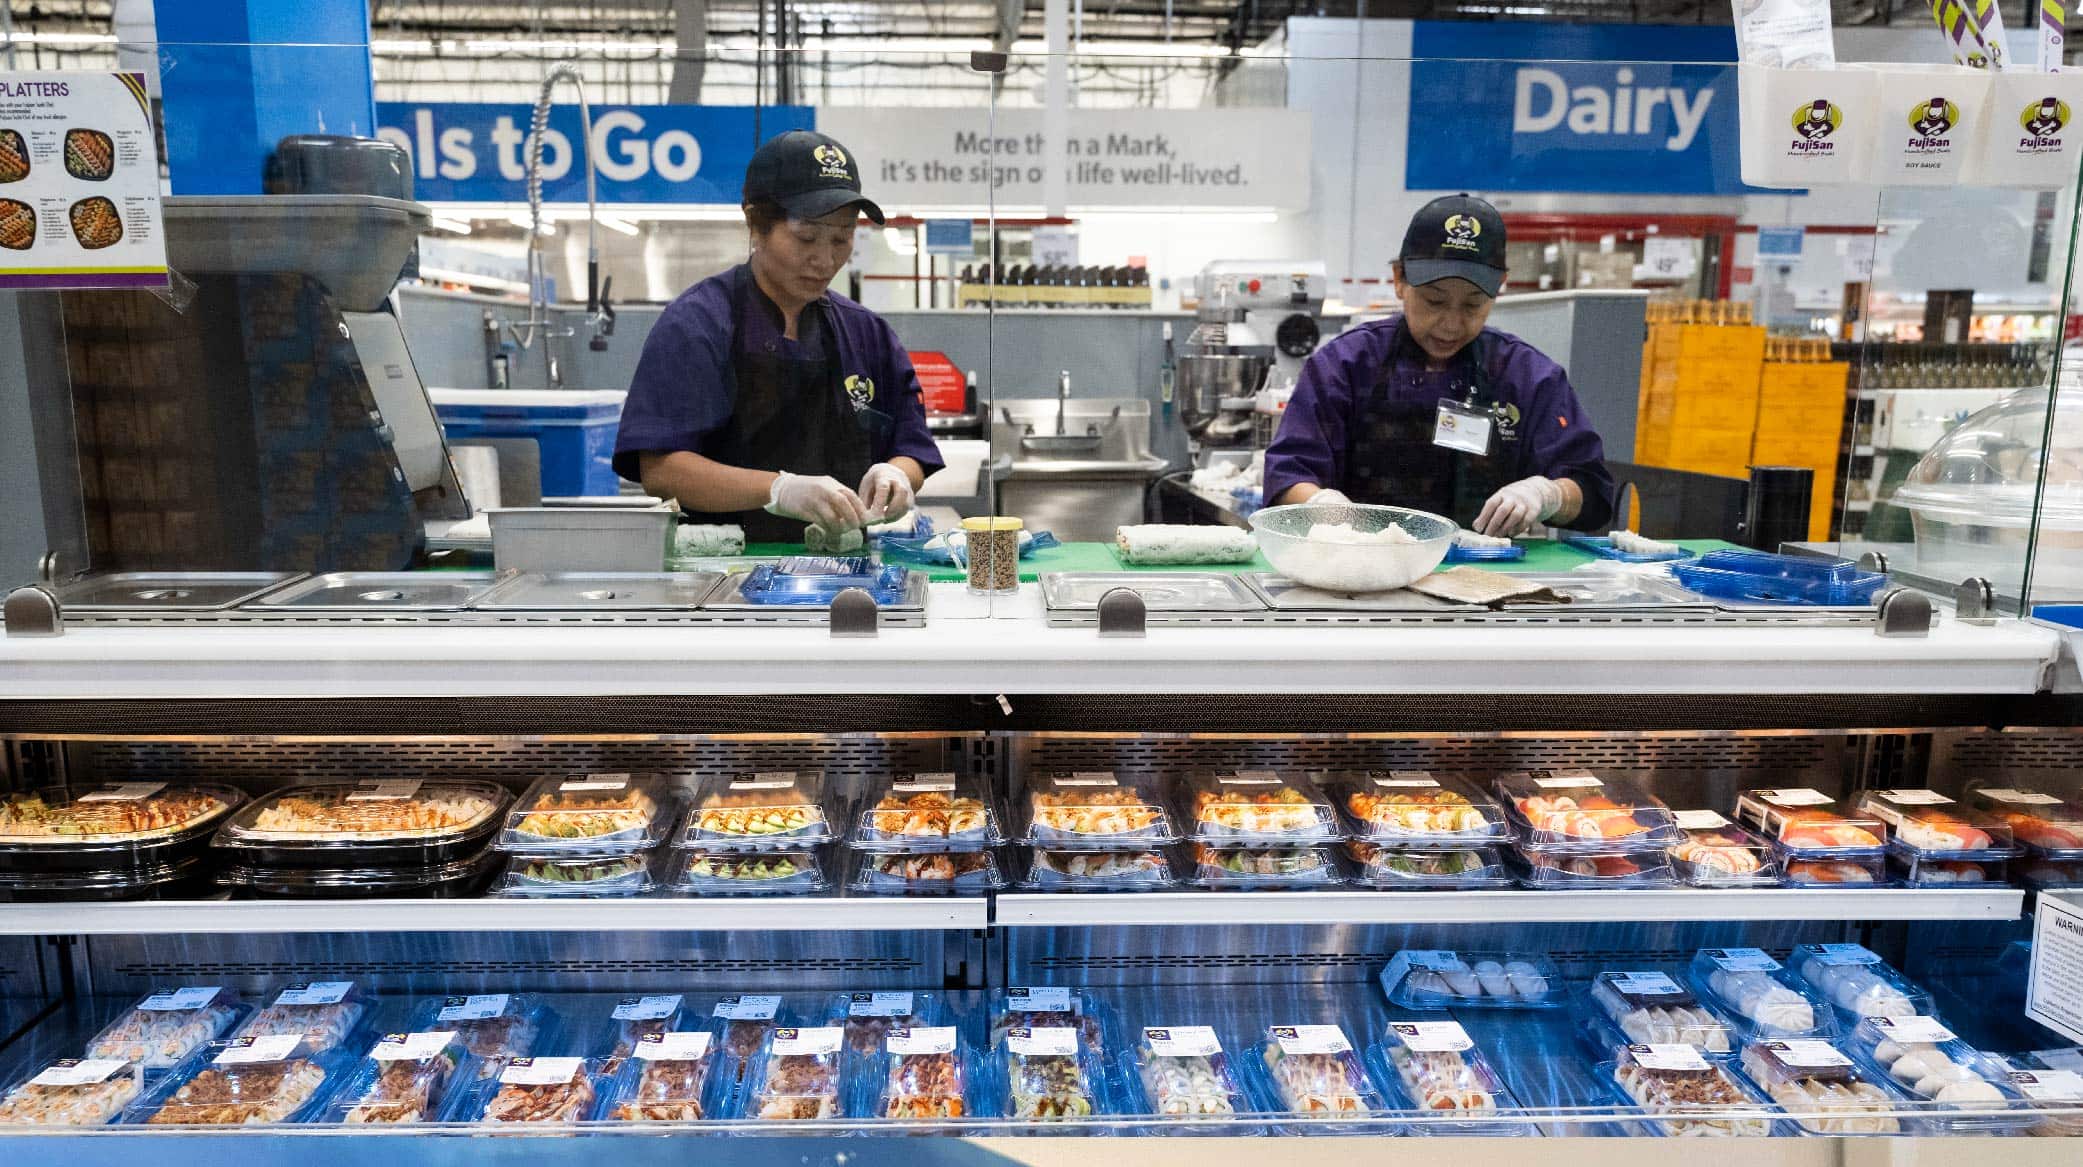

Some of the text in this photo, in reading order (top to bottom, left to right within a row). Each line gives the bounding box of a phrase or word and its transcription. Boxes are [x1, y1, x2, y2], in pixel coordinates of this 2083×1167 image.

[1514, 67, 1713, 151] Dairy
[491, 116, 573, 181] to
[592, 110, 702, 182] Go
[955, 132, 1176, 160] More thn a Mark,
[1791, 140, 1834, 152] FujiSan
[1908, 137, 1950, 149] FujiSan
[2020, 135, 2062, 149] FujiSan
[881, 160, 916, 182] it's
[922, 160, 963, 182] the
[968, 163, 1020, 188] sign
[1077, 161, 1114, 184] life
[1120, 162, 1248, 185] well-lived.
